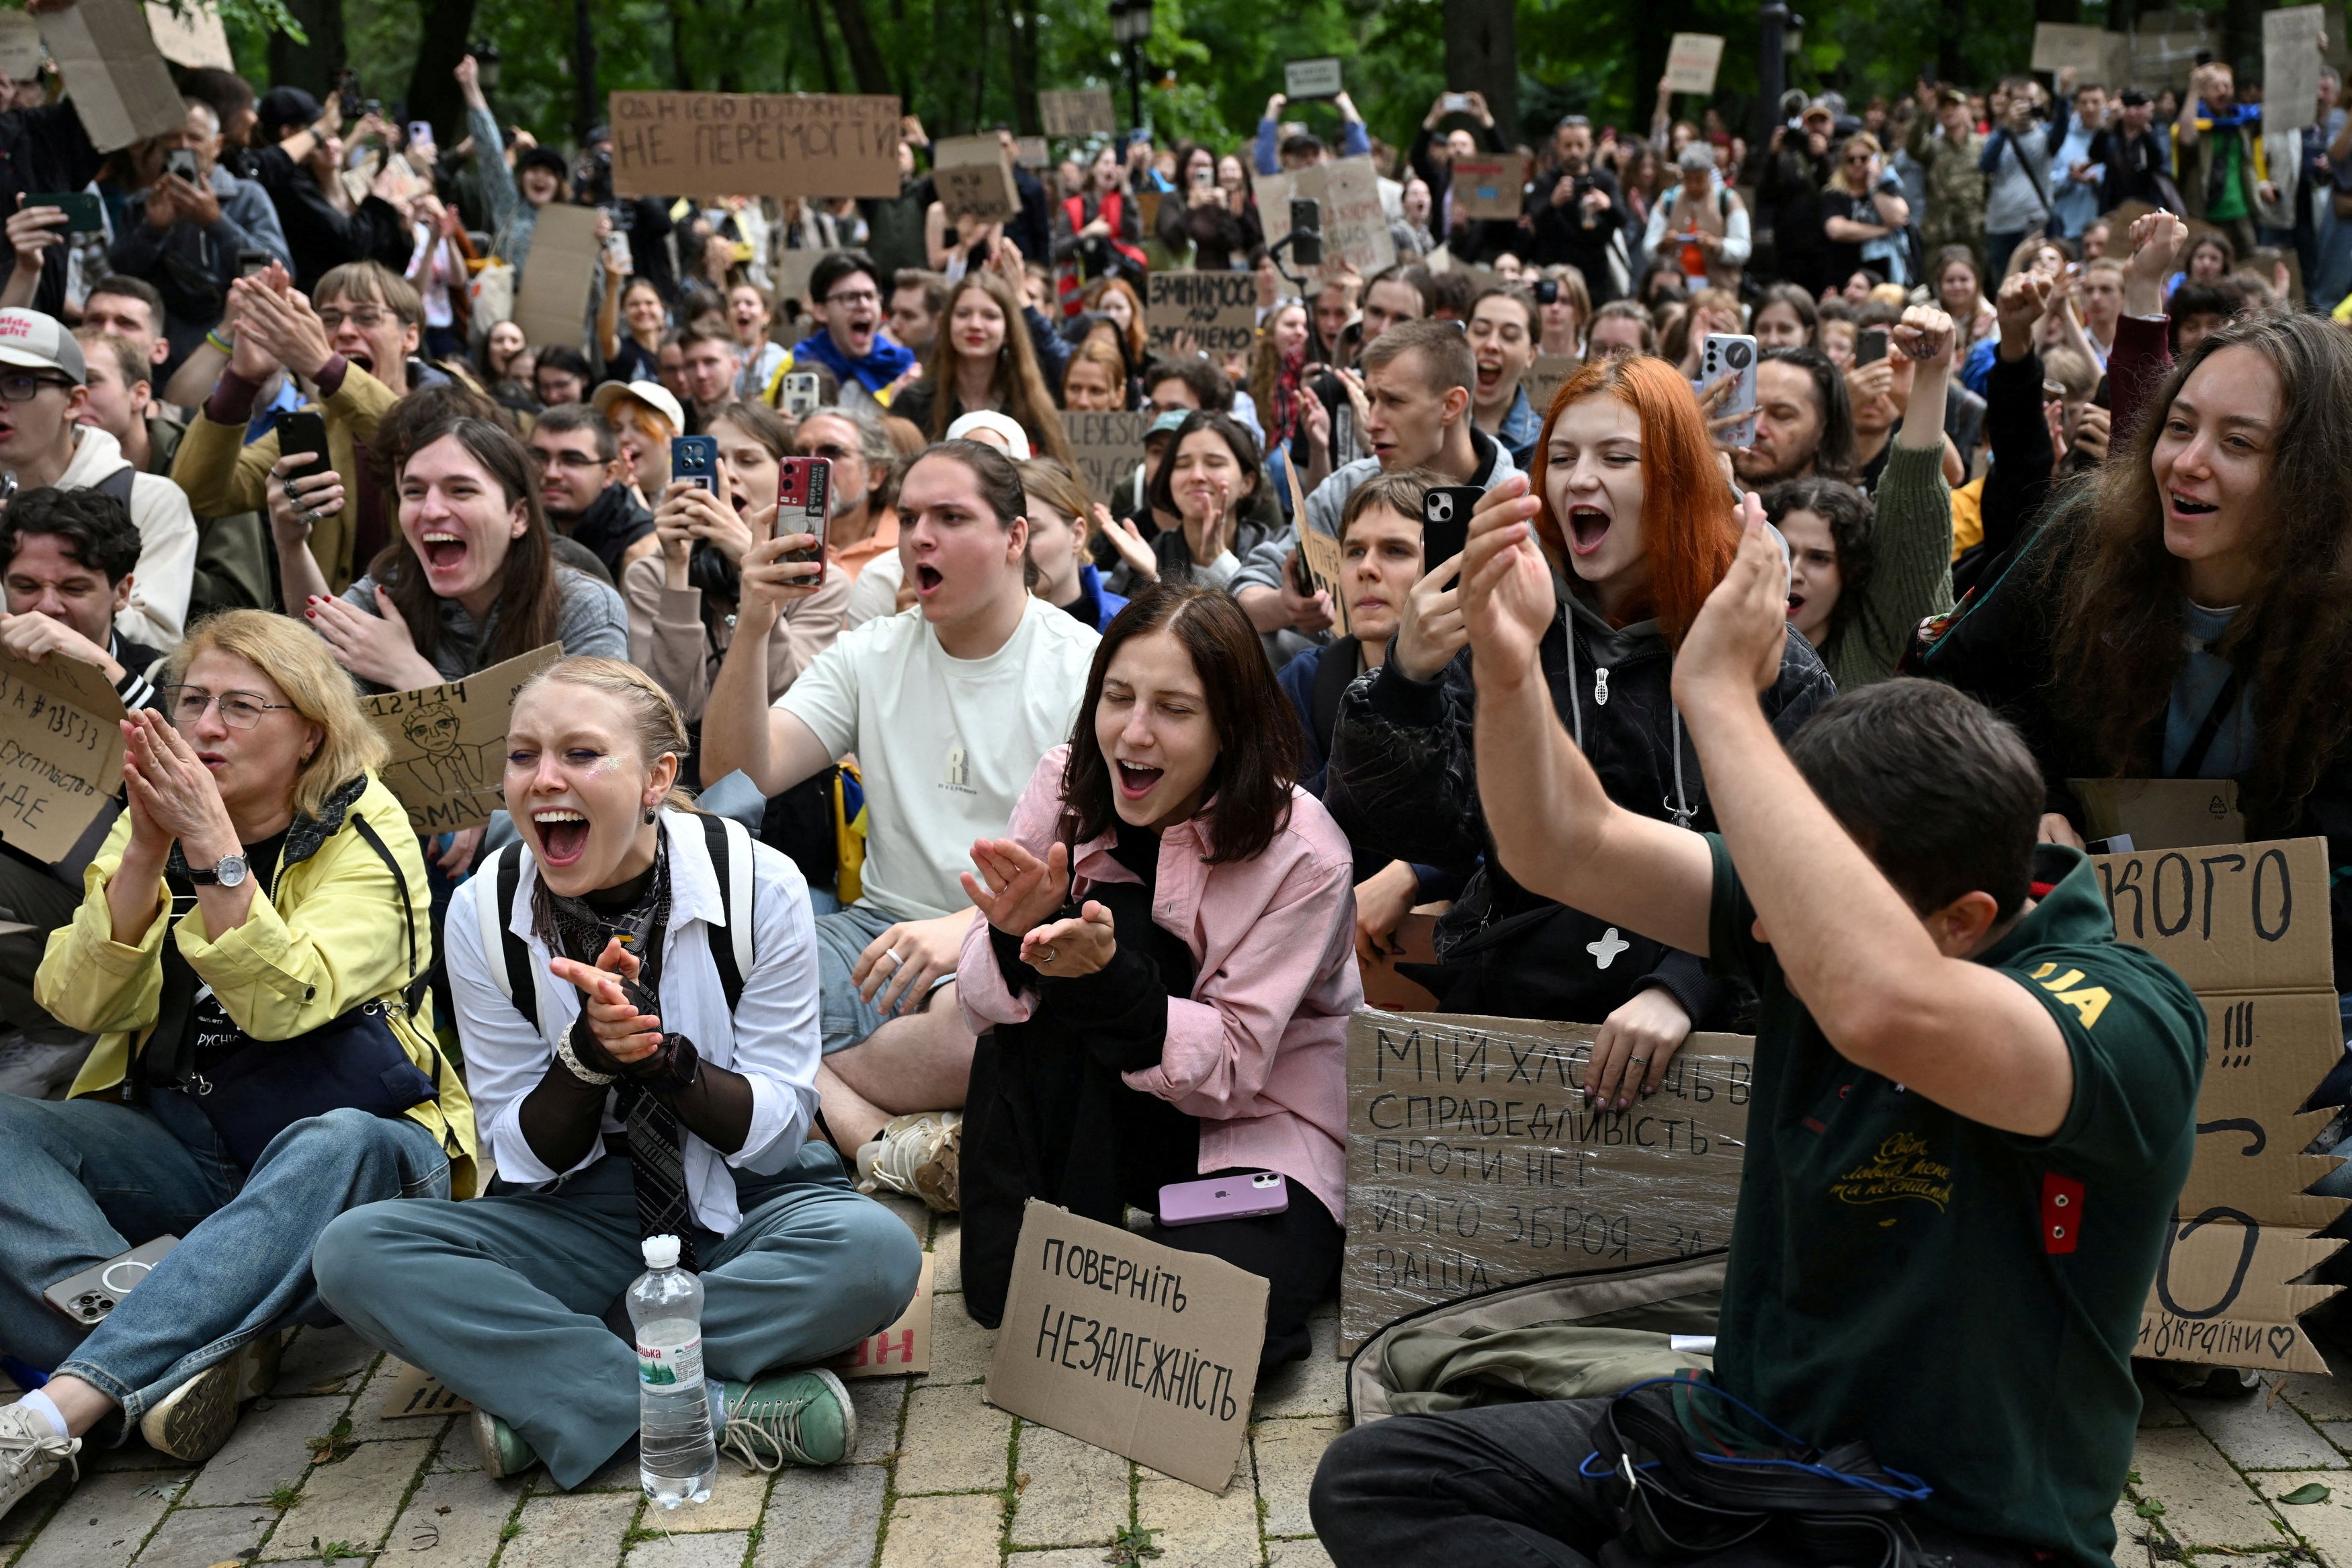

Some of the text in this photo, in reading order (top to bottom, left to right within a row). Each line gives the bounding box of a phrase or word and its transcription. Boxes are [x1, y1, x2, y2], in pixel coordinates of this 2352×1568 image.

[618, 121, 896, 168] НЕ ПЕРЕМОГТИ
[816, 466, 825, 496] LACHEN
[1377, 1029, 1486, 1084] МІЙ
[1369, 1094, 1709, 1156] СПРАВЕДЛИВІСТЬ
[1374, 1139, 1502, 1184] ПРОТИ
[1375, 1190, 1481, 1239] ЙОГО
[1503, 1205, 1630, 1263] ЗБРОЯ
